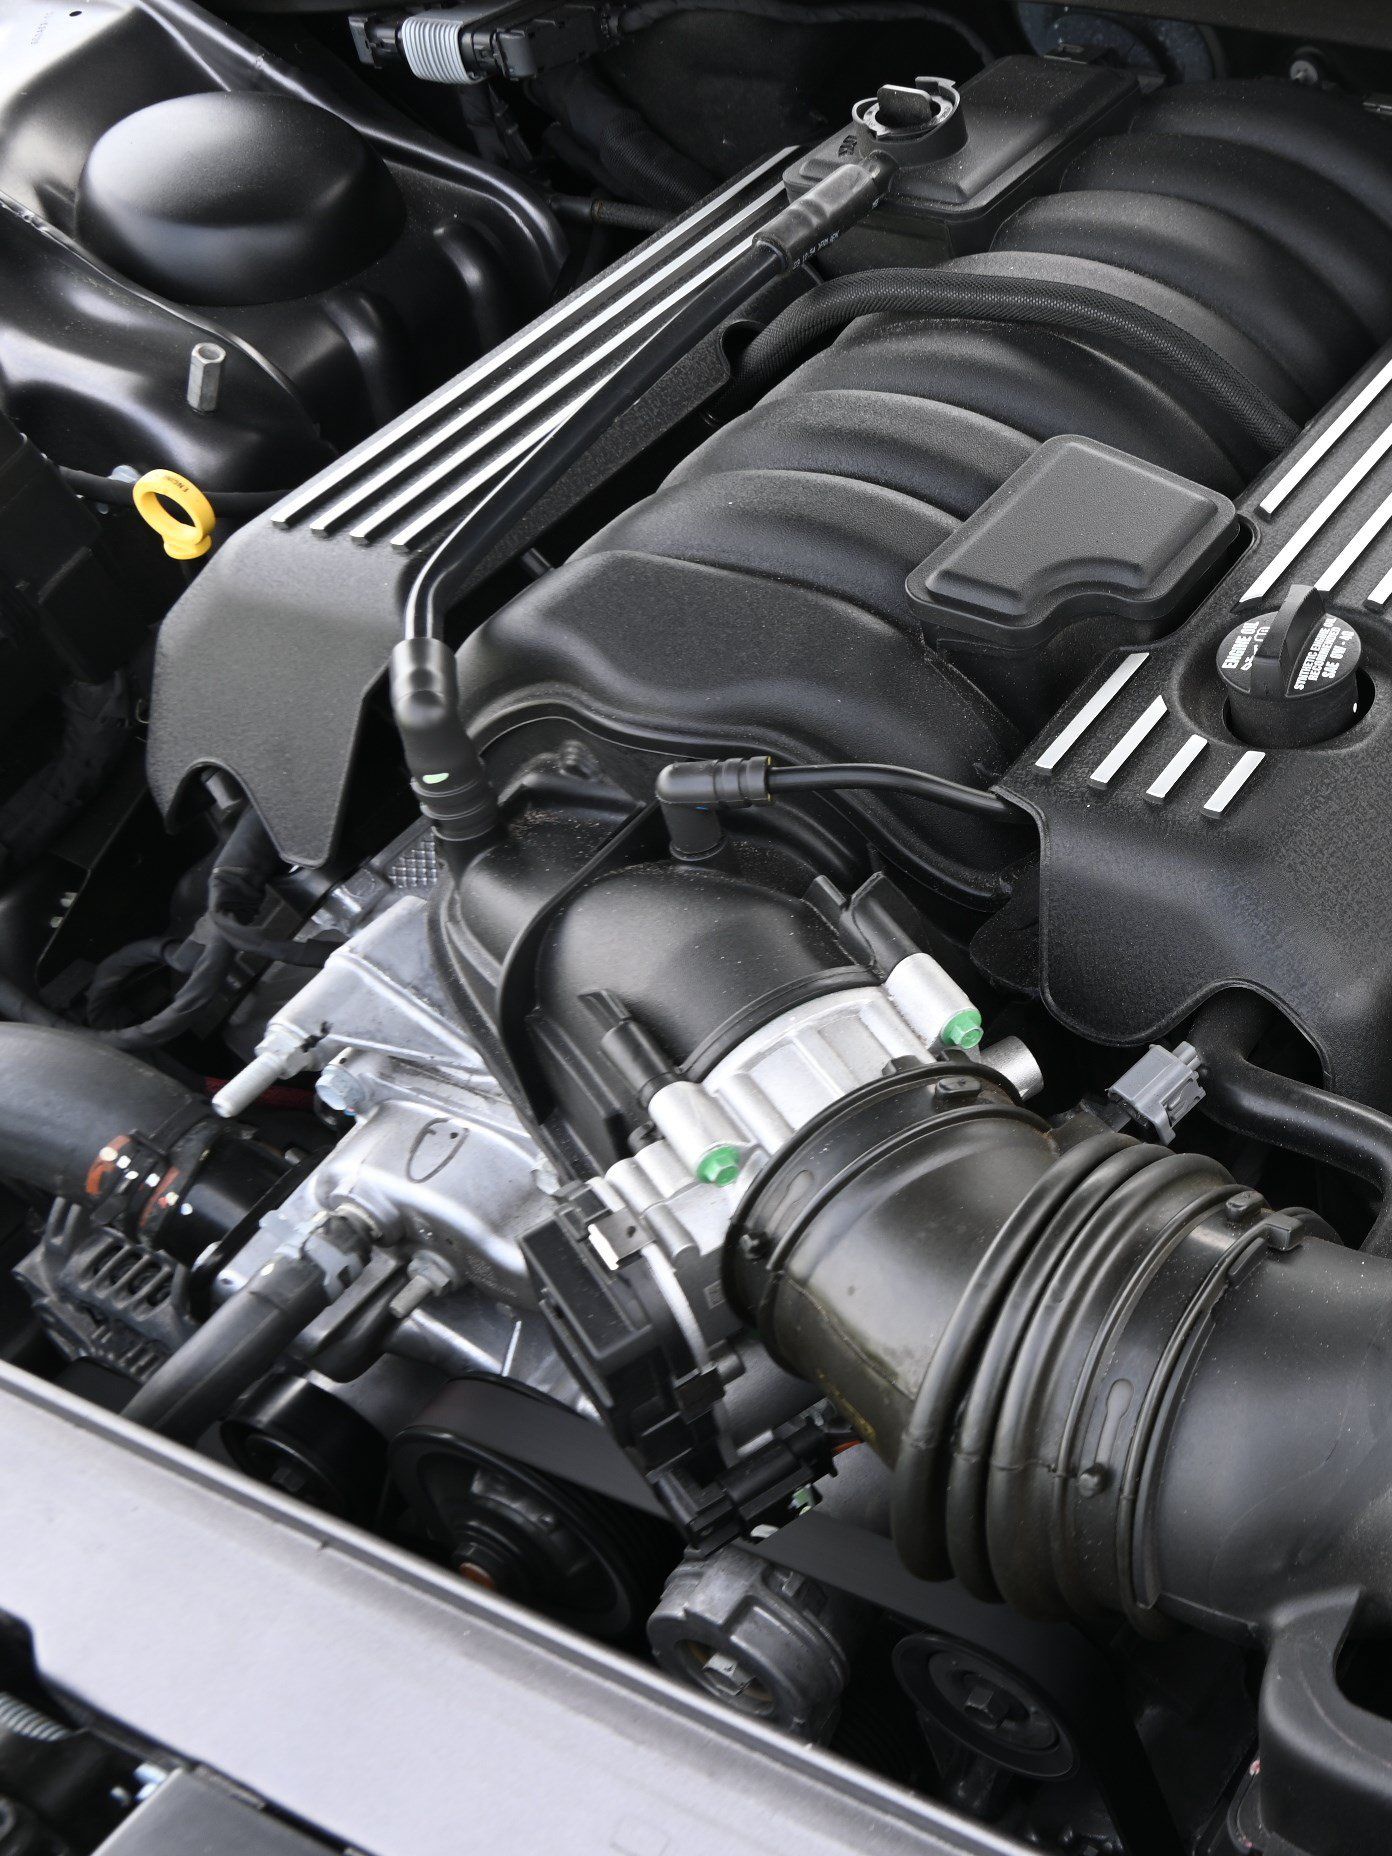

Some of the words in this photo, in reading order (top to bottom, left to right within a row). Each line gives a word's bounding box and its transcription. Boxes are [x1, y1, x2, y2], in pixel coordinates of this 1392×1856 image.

[1222, 635, 1252, 669] ENGINE
[1241, 621, 1260, 635] OIL
[1294, 651, 1318, 691] SYNTHETIC
[1309, 627, 1331, 651] ENGINE
[1324, 617, 1338, 629] OIL
[1308, 627, 1341, 681] RECOMMENDED
[1322, 660, 1340, 680] SAE
